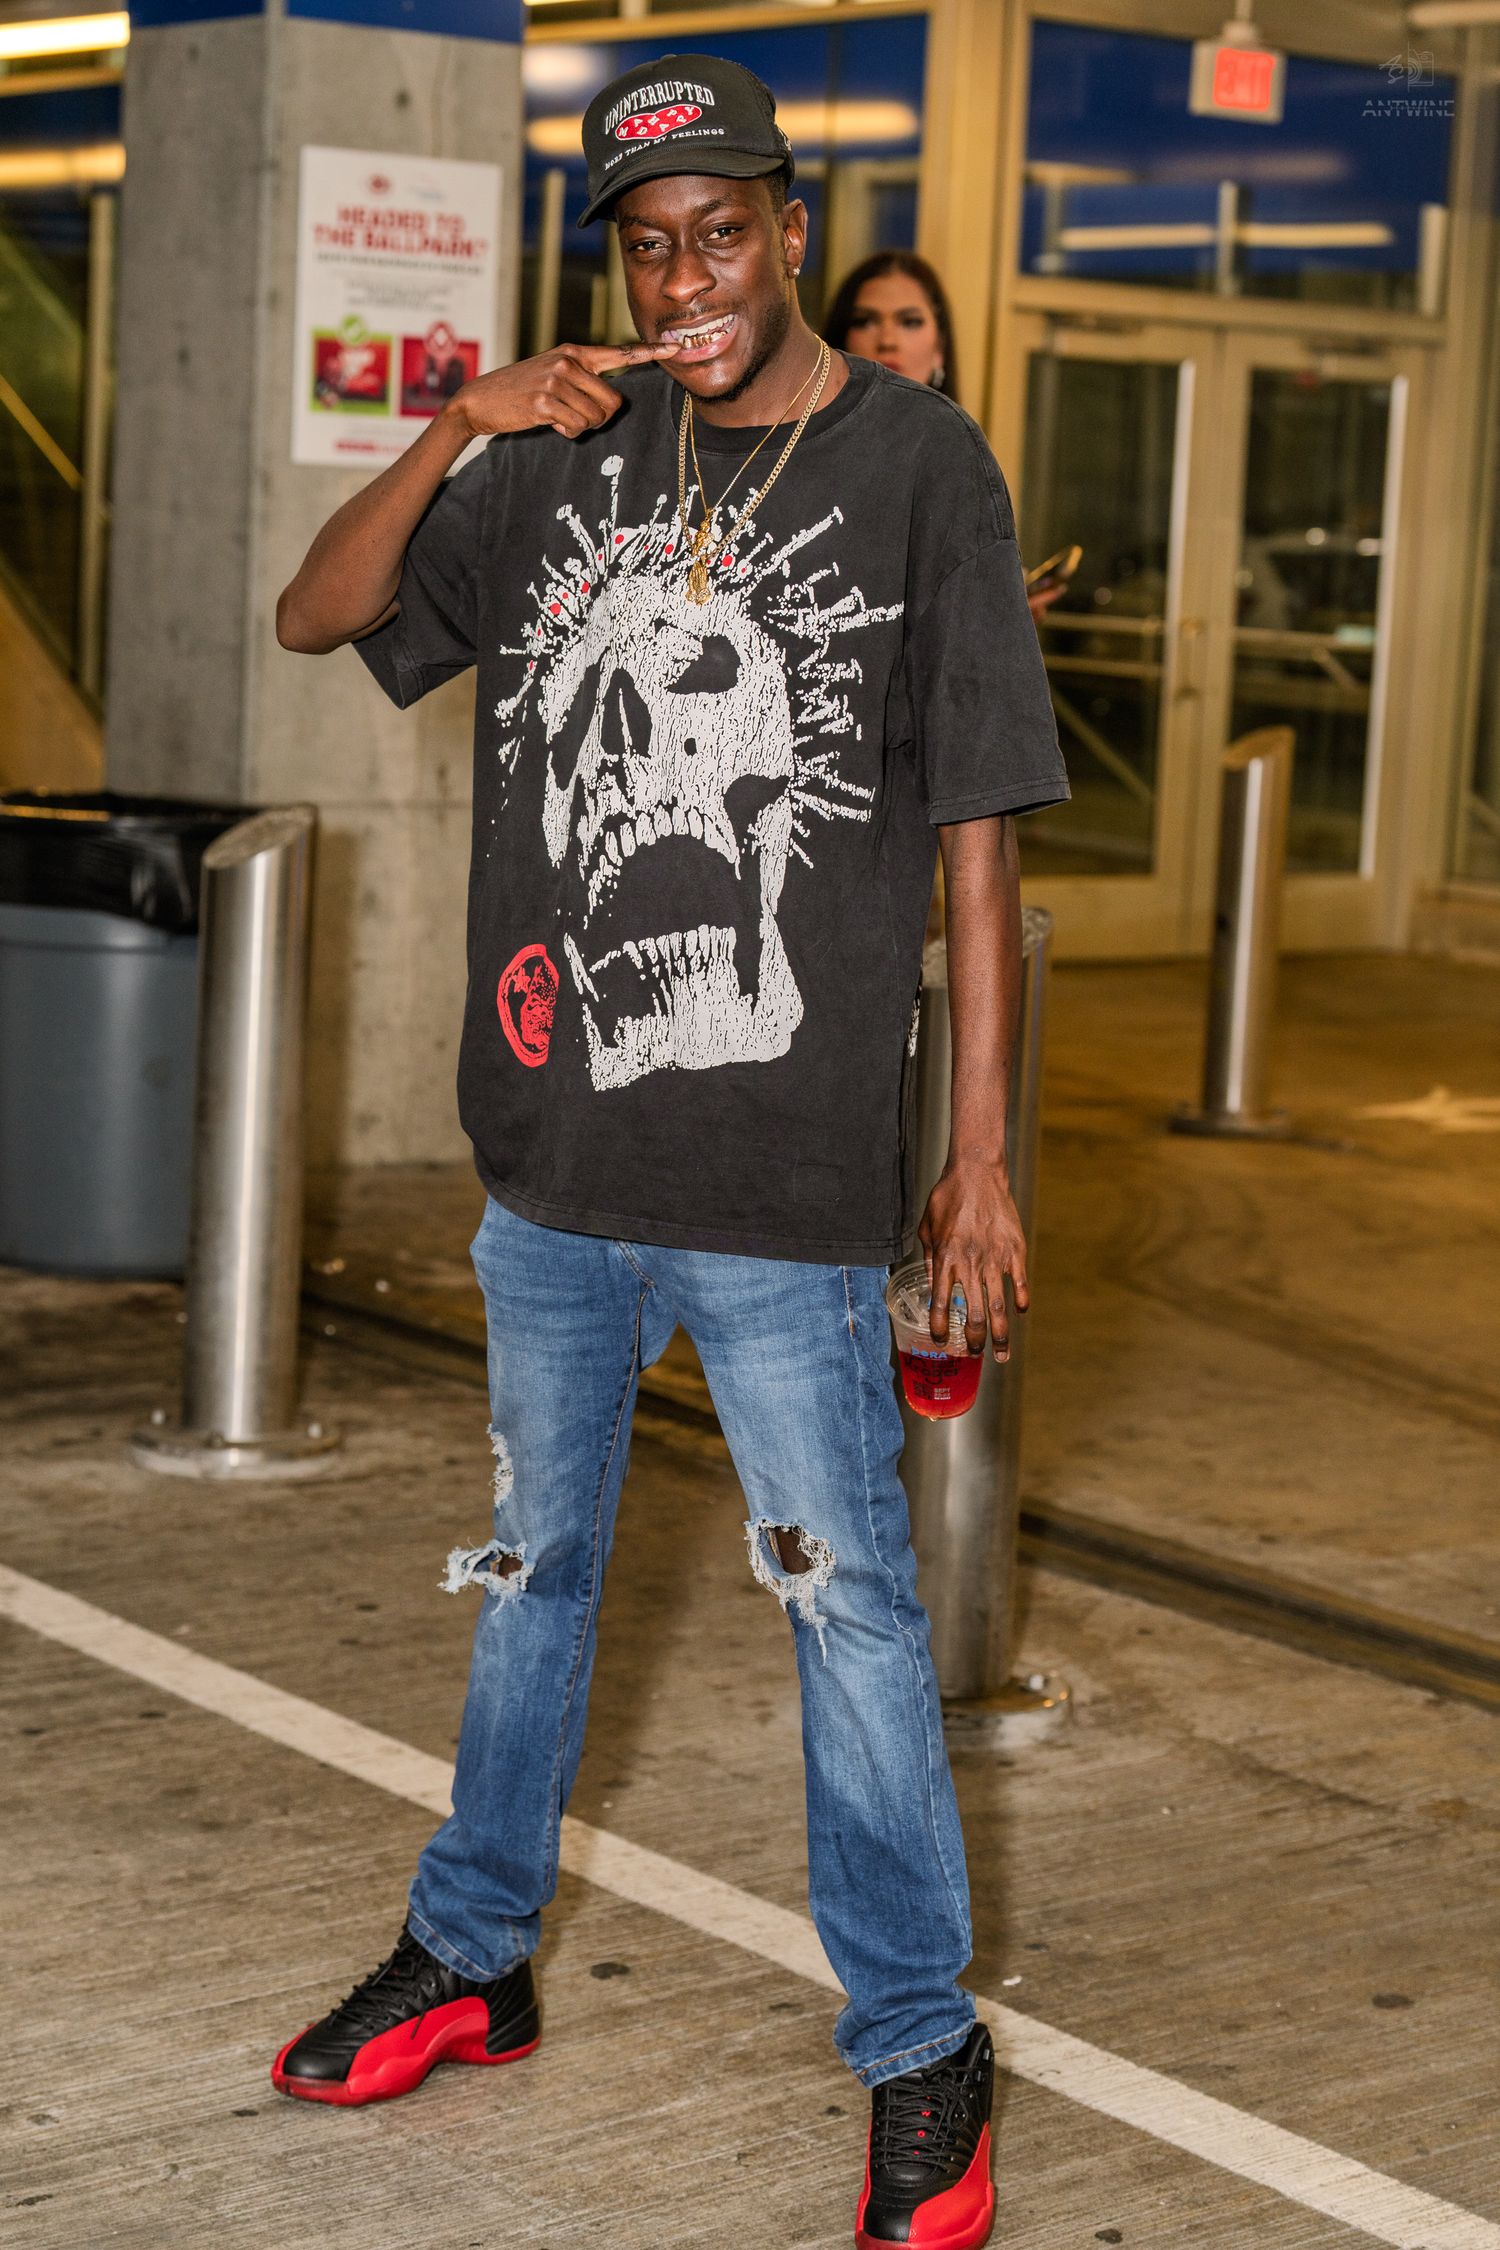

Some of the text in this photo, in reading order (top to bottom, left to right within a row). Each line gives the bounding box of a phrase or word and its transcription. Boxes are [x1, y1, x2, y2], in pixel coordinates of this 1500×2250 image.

[604, 80, 715, 136] UNINTERRUPTED
[625, 141, 651, 157] THAN
[653, 135, 668, 145] MY
[671, 128, 725, 140] FEELINGS
[312, 223, 356, 247] THE
